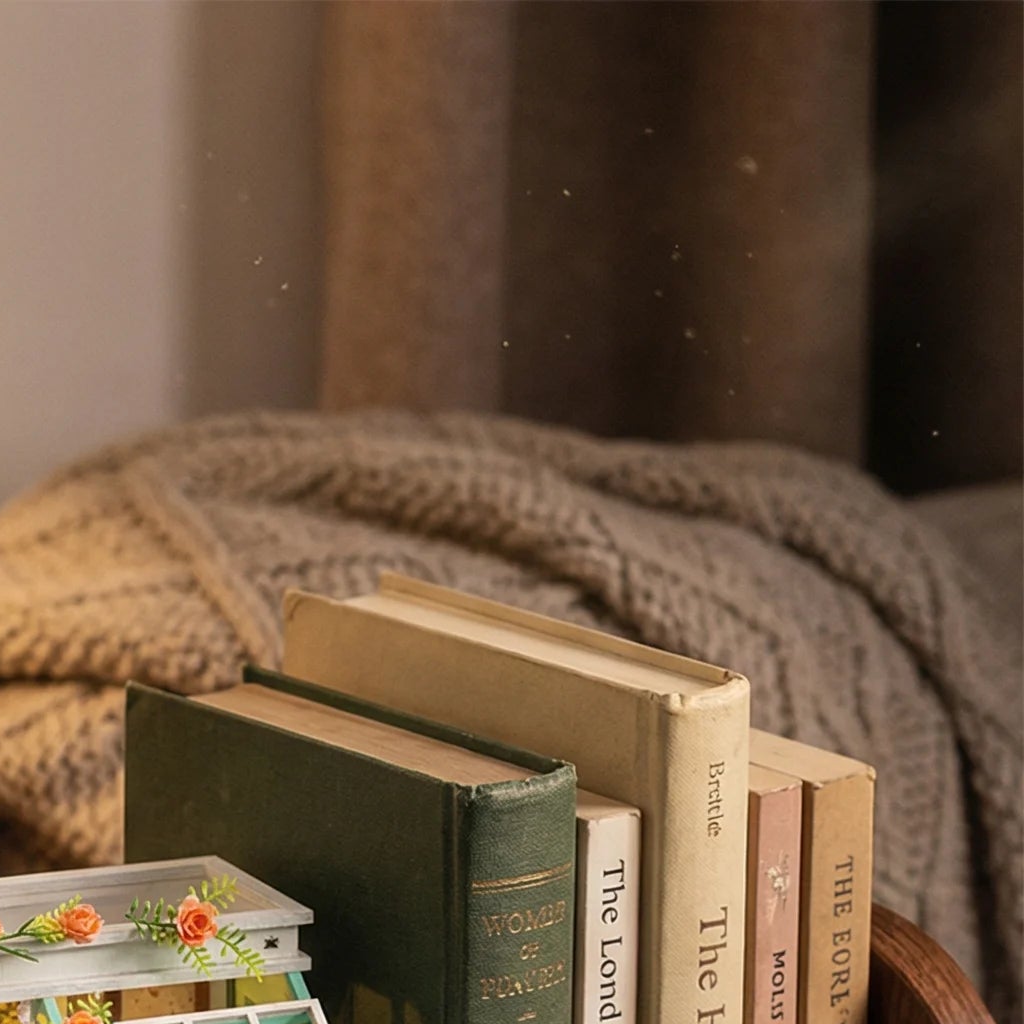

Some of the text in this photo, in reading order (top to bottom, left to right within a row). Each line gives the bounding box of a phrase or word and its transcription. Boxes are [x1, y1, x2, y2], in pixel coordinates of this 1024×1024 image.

[600, 858, 625, 924] The
[833, 854, 854, 918] THE
[598, 936, 623, 1023] Lond
[698, 906, 729, 992] The
